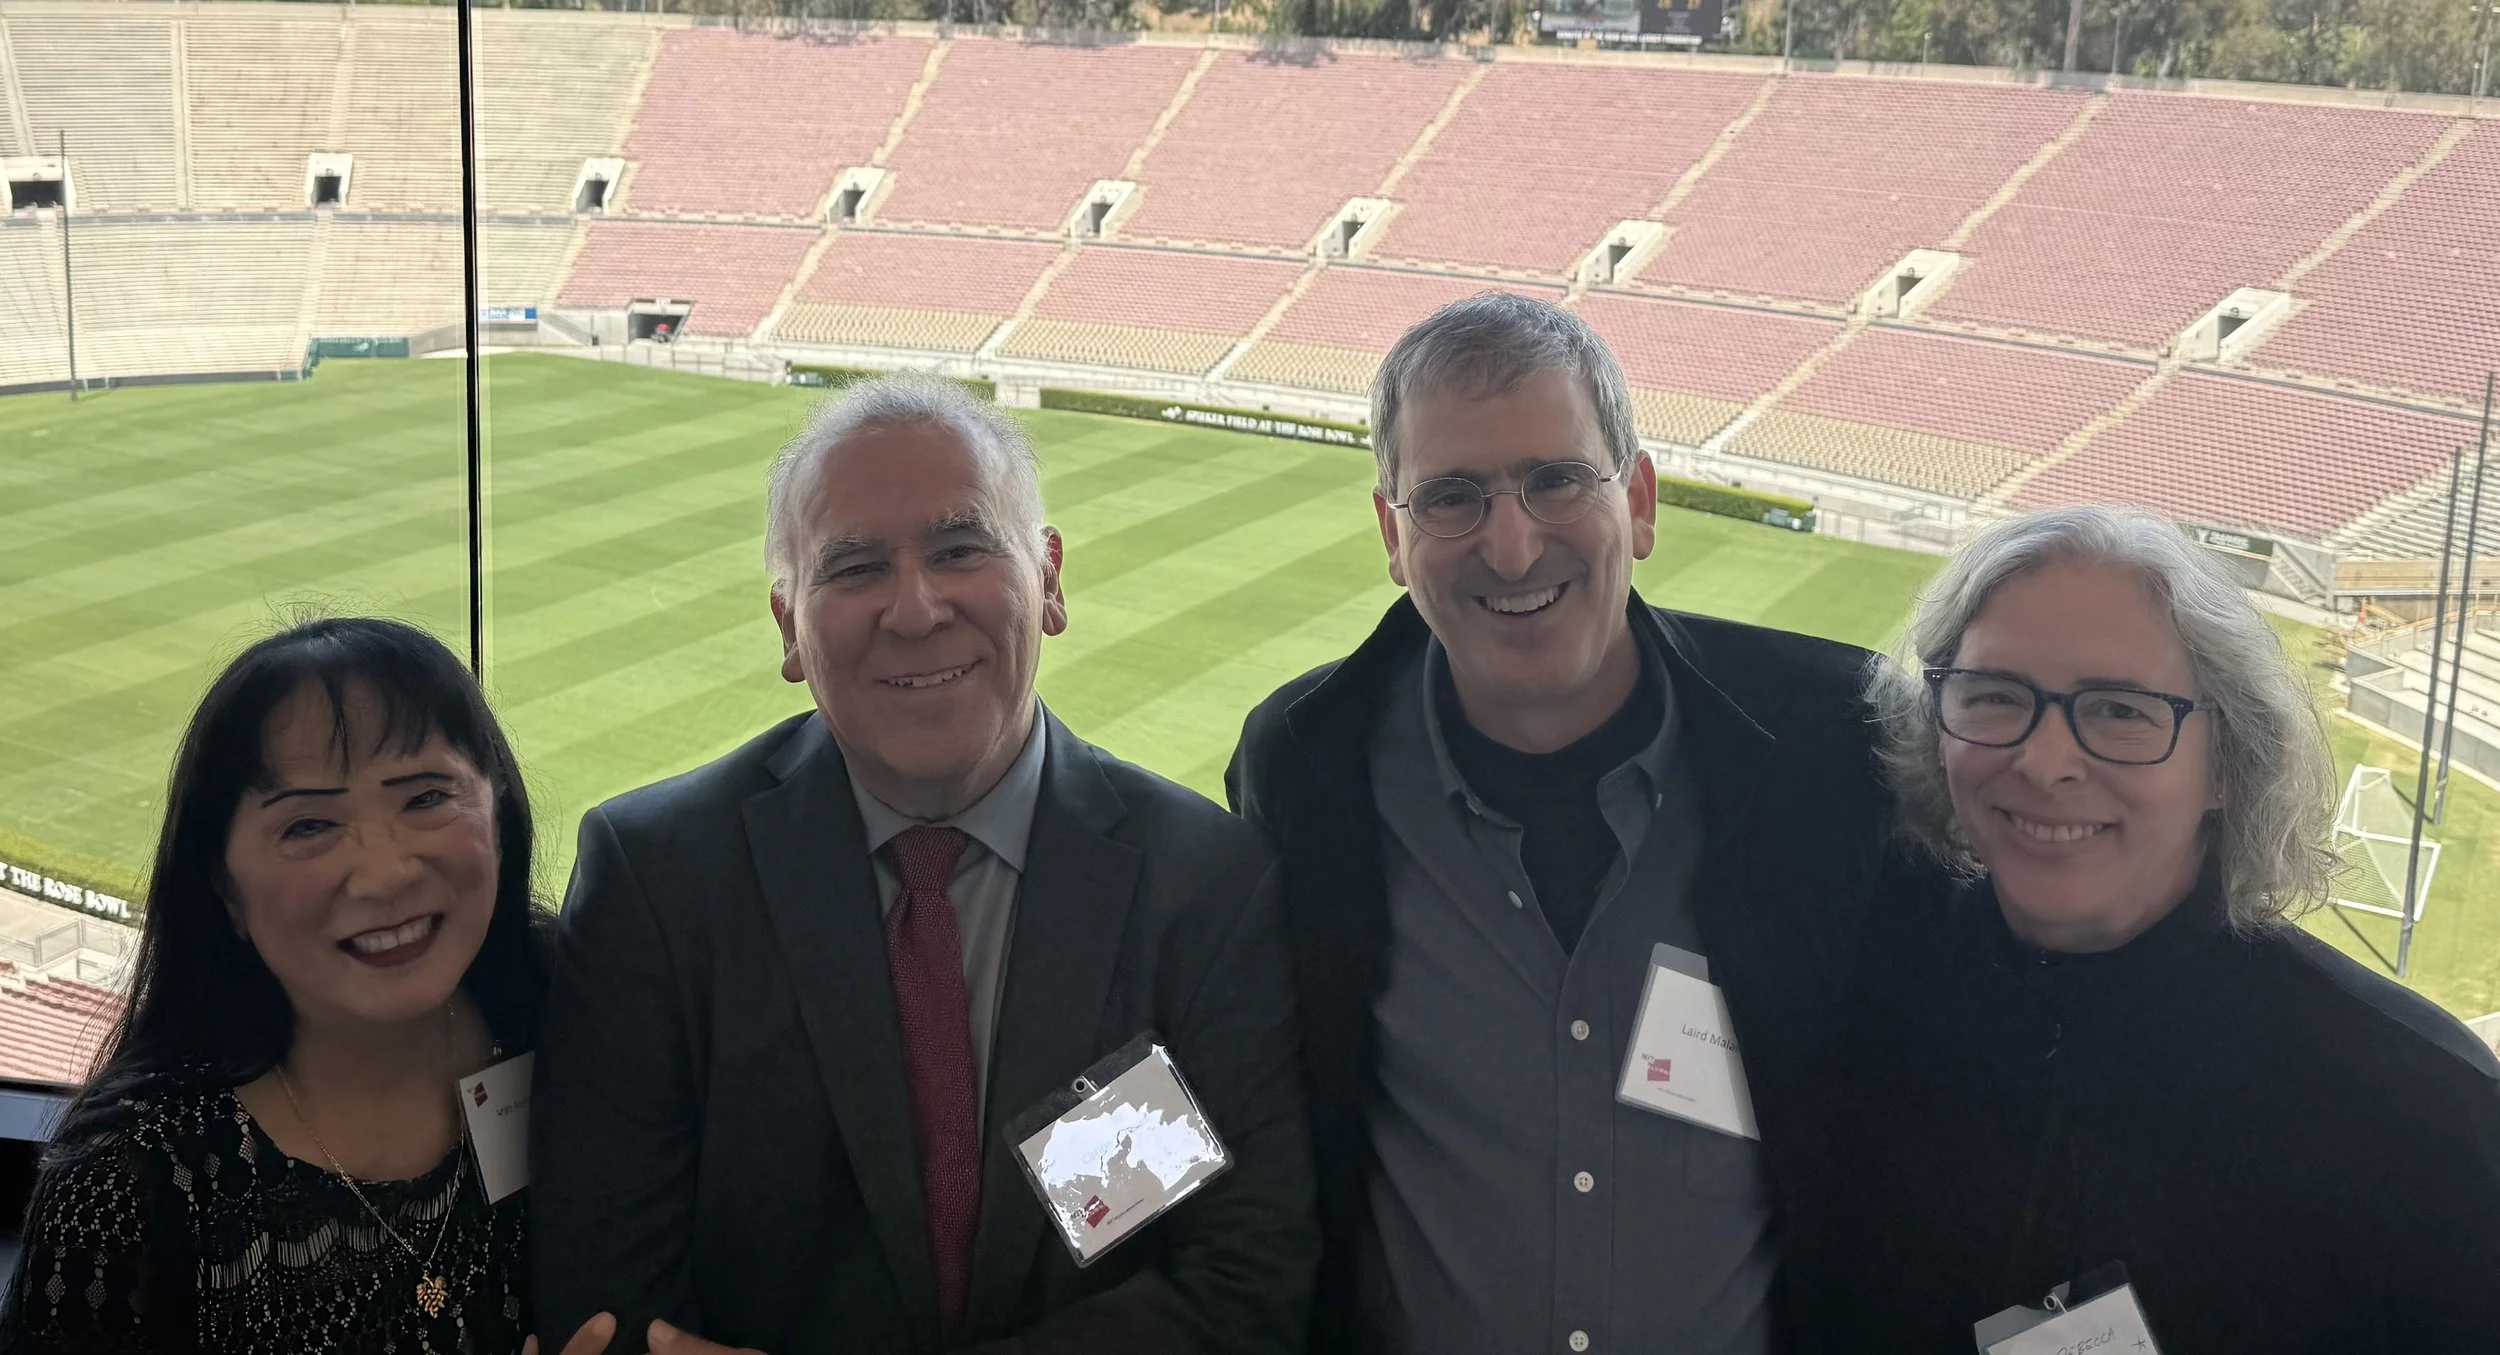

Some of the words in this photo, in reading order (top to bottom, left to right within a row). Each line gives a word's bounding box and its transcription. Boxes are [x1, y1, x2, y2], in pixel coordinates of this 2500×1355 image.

[9, 865, 42, 892] THE
[43, 877, 83, 904] ROSE
[85, 889, 131, 918] BOWL
[1681, 1023, 1708, 1041] Laird
